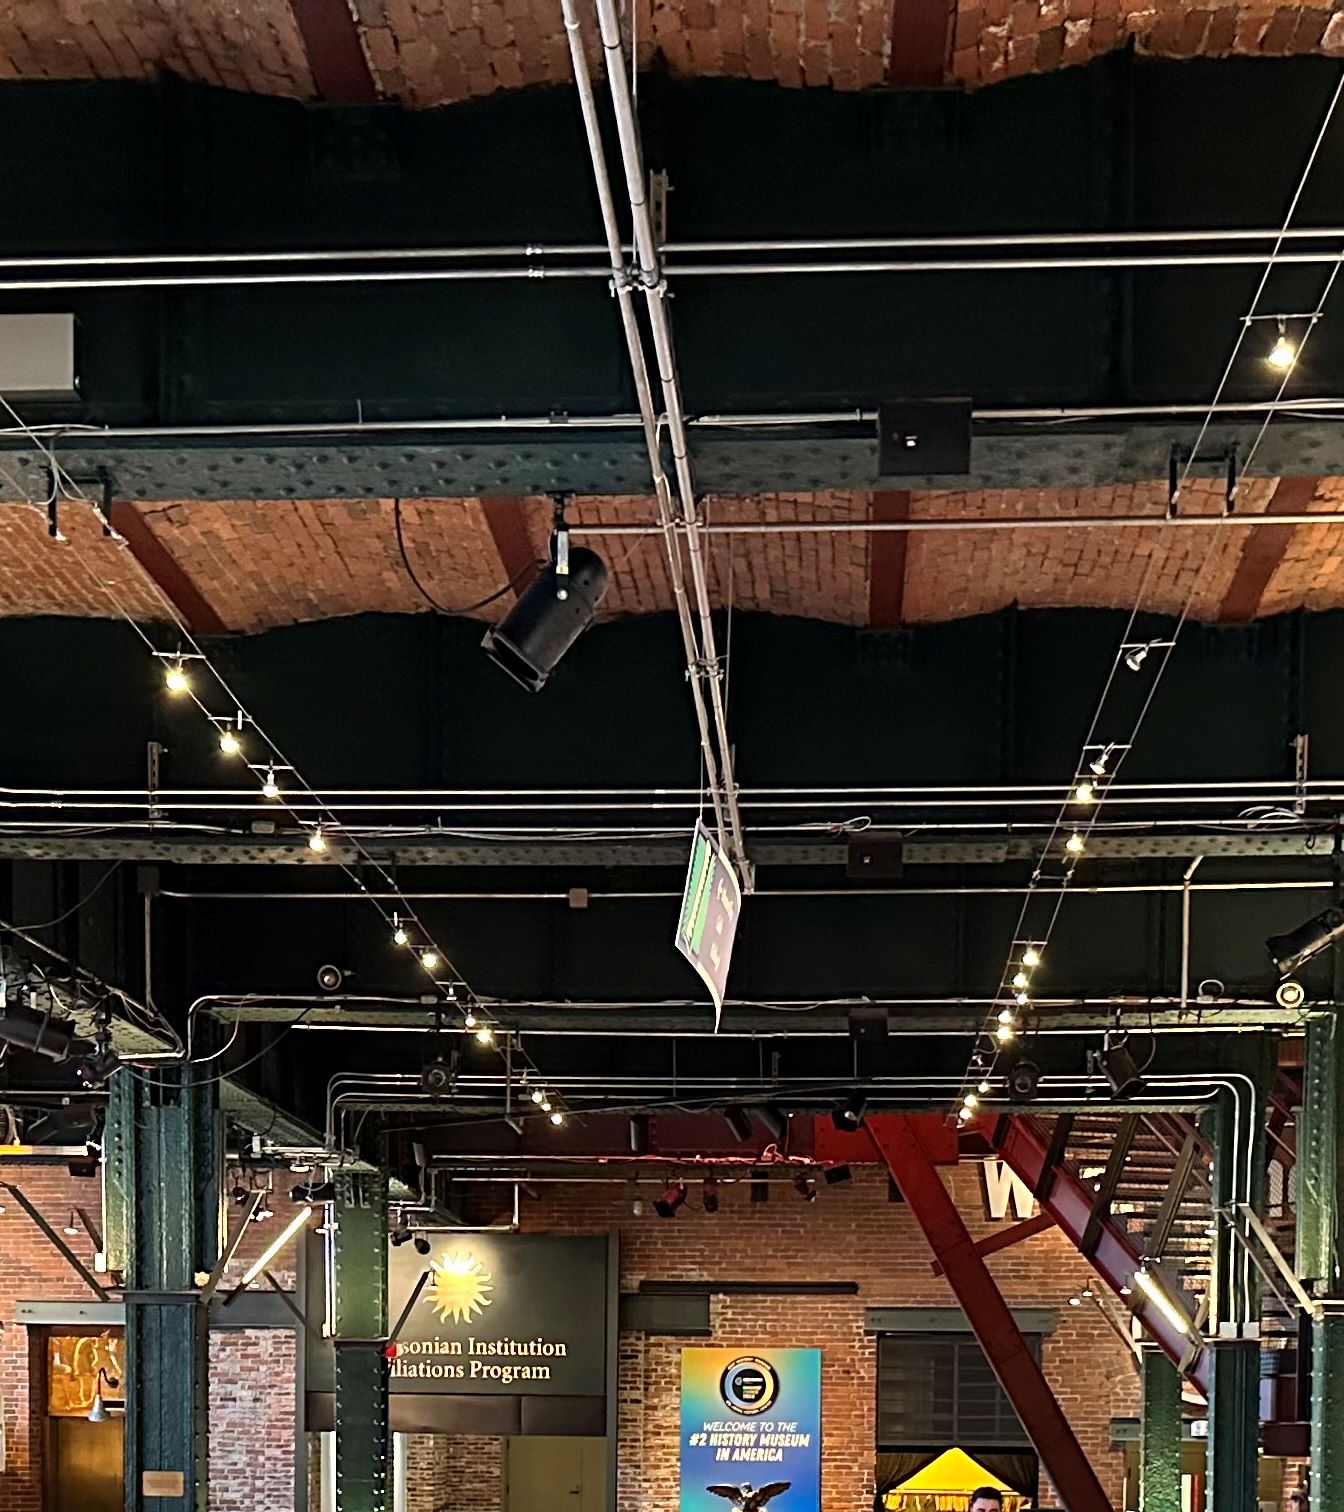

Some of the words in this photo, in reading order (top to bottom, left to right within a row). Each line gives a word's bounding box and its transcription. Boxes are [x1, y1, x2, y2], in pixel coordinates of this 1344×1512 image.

[396, 1336, 462, 1356] sonian
[468, 1336, 567, 1357] Institution
[469, 1360, 551, 1384] Program
[703, 1421, 757, 1432] WELCOME
[759, 1421, 774, 1432] TO
[777, 1421, 798, 1432] THE
[688, 1433, 708, 1446] #2
[709, 1433, 758, 1447] HISTORY
[759, 1433, 811, 1447] MUSEUM
[715, 1448, 731, 1461] IN
[731, 1447, 783, 1462] AMERICA
